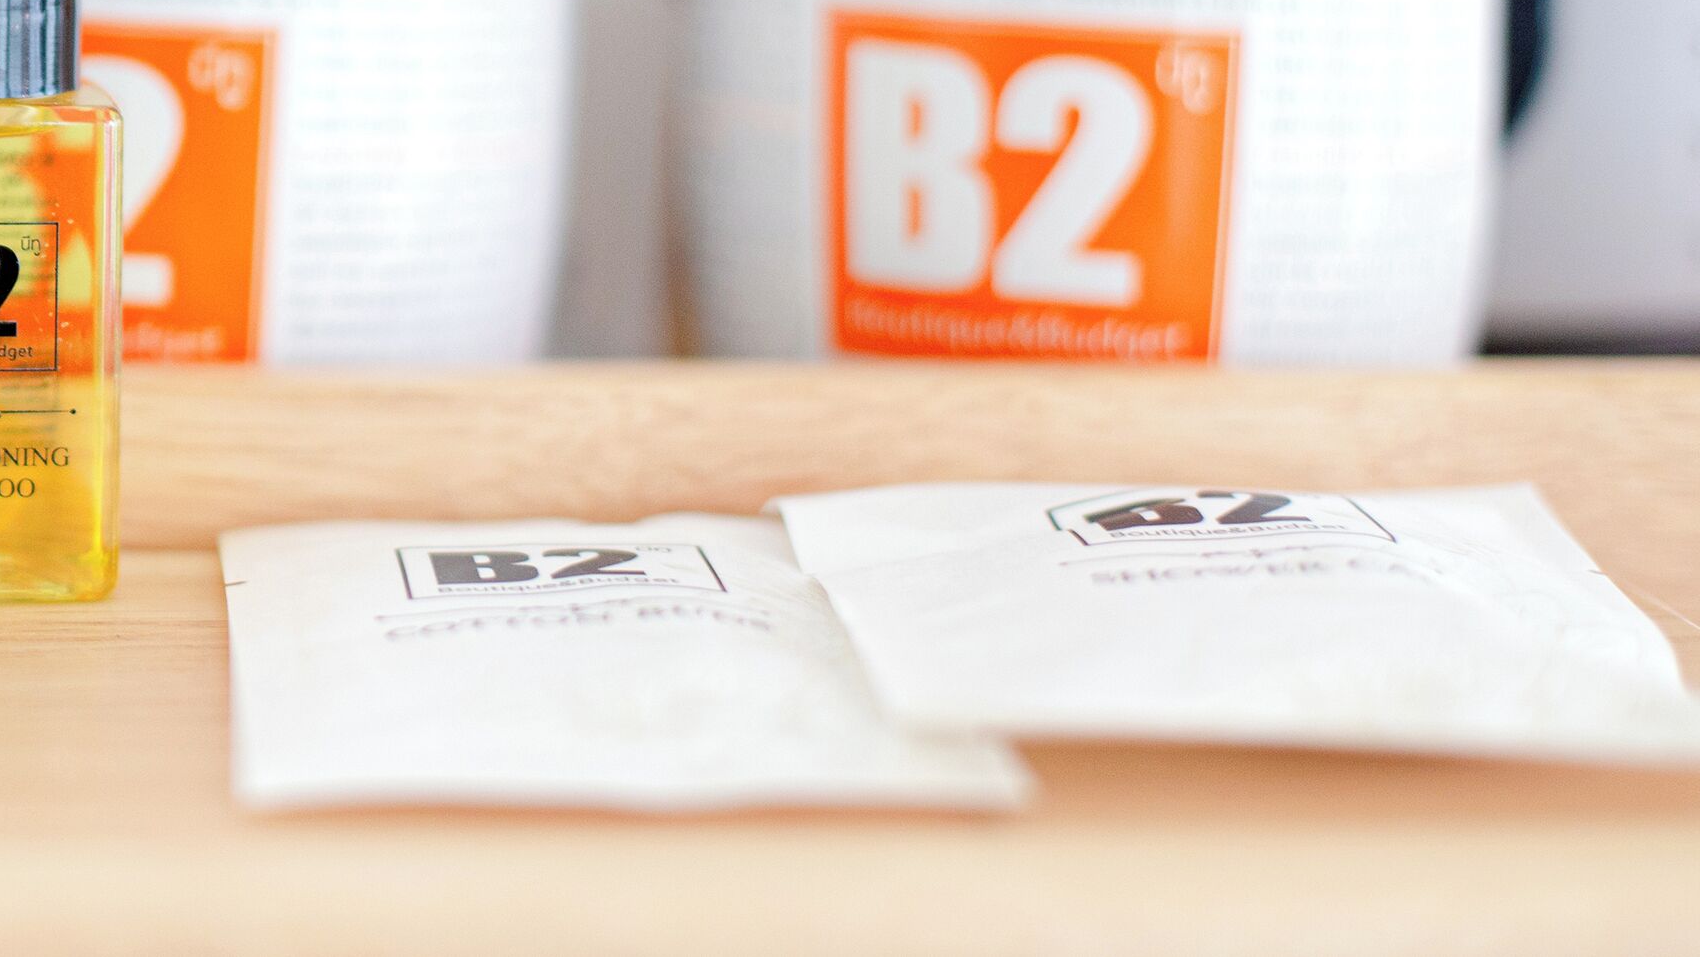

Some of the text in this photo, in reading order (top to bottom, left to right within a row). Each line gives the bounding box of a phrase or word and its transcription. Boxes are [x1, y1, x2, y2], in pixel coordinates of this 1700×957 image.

[843, 37, 1157, 310] B2
[1108, 521, 1348, 540] Boutique&Budget
[429, 548, 646, 586] B2
[436, 574, 681, 594] Boutique&Budget
